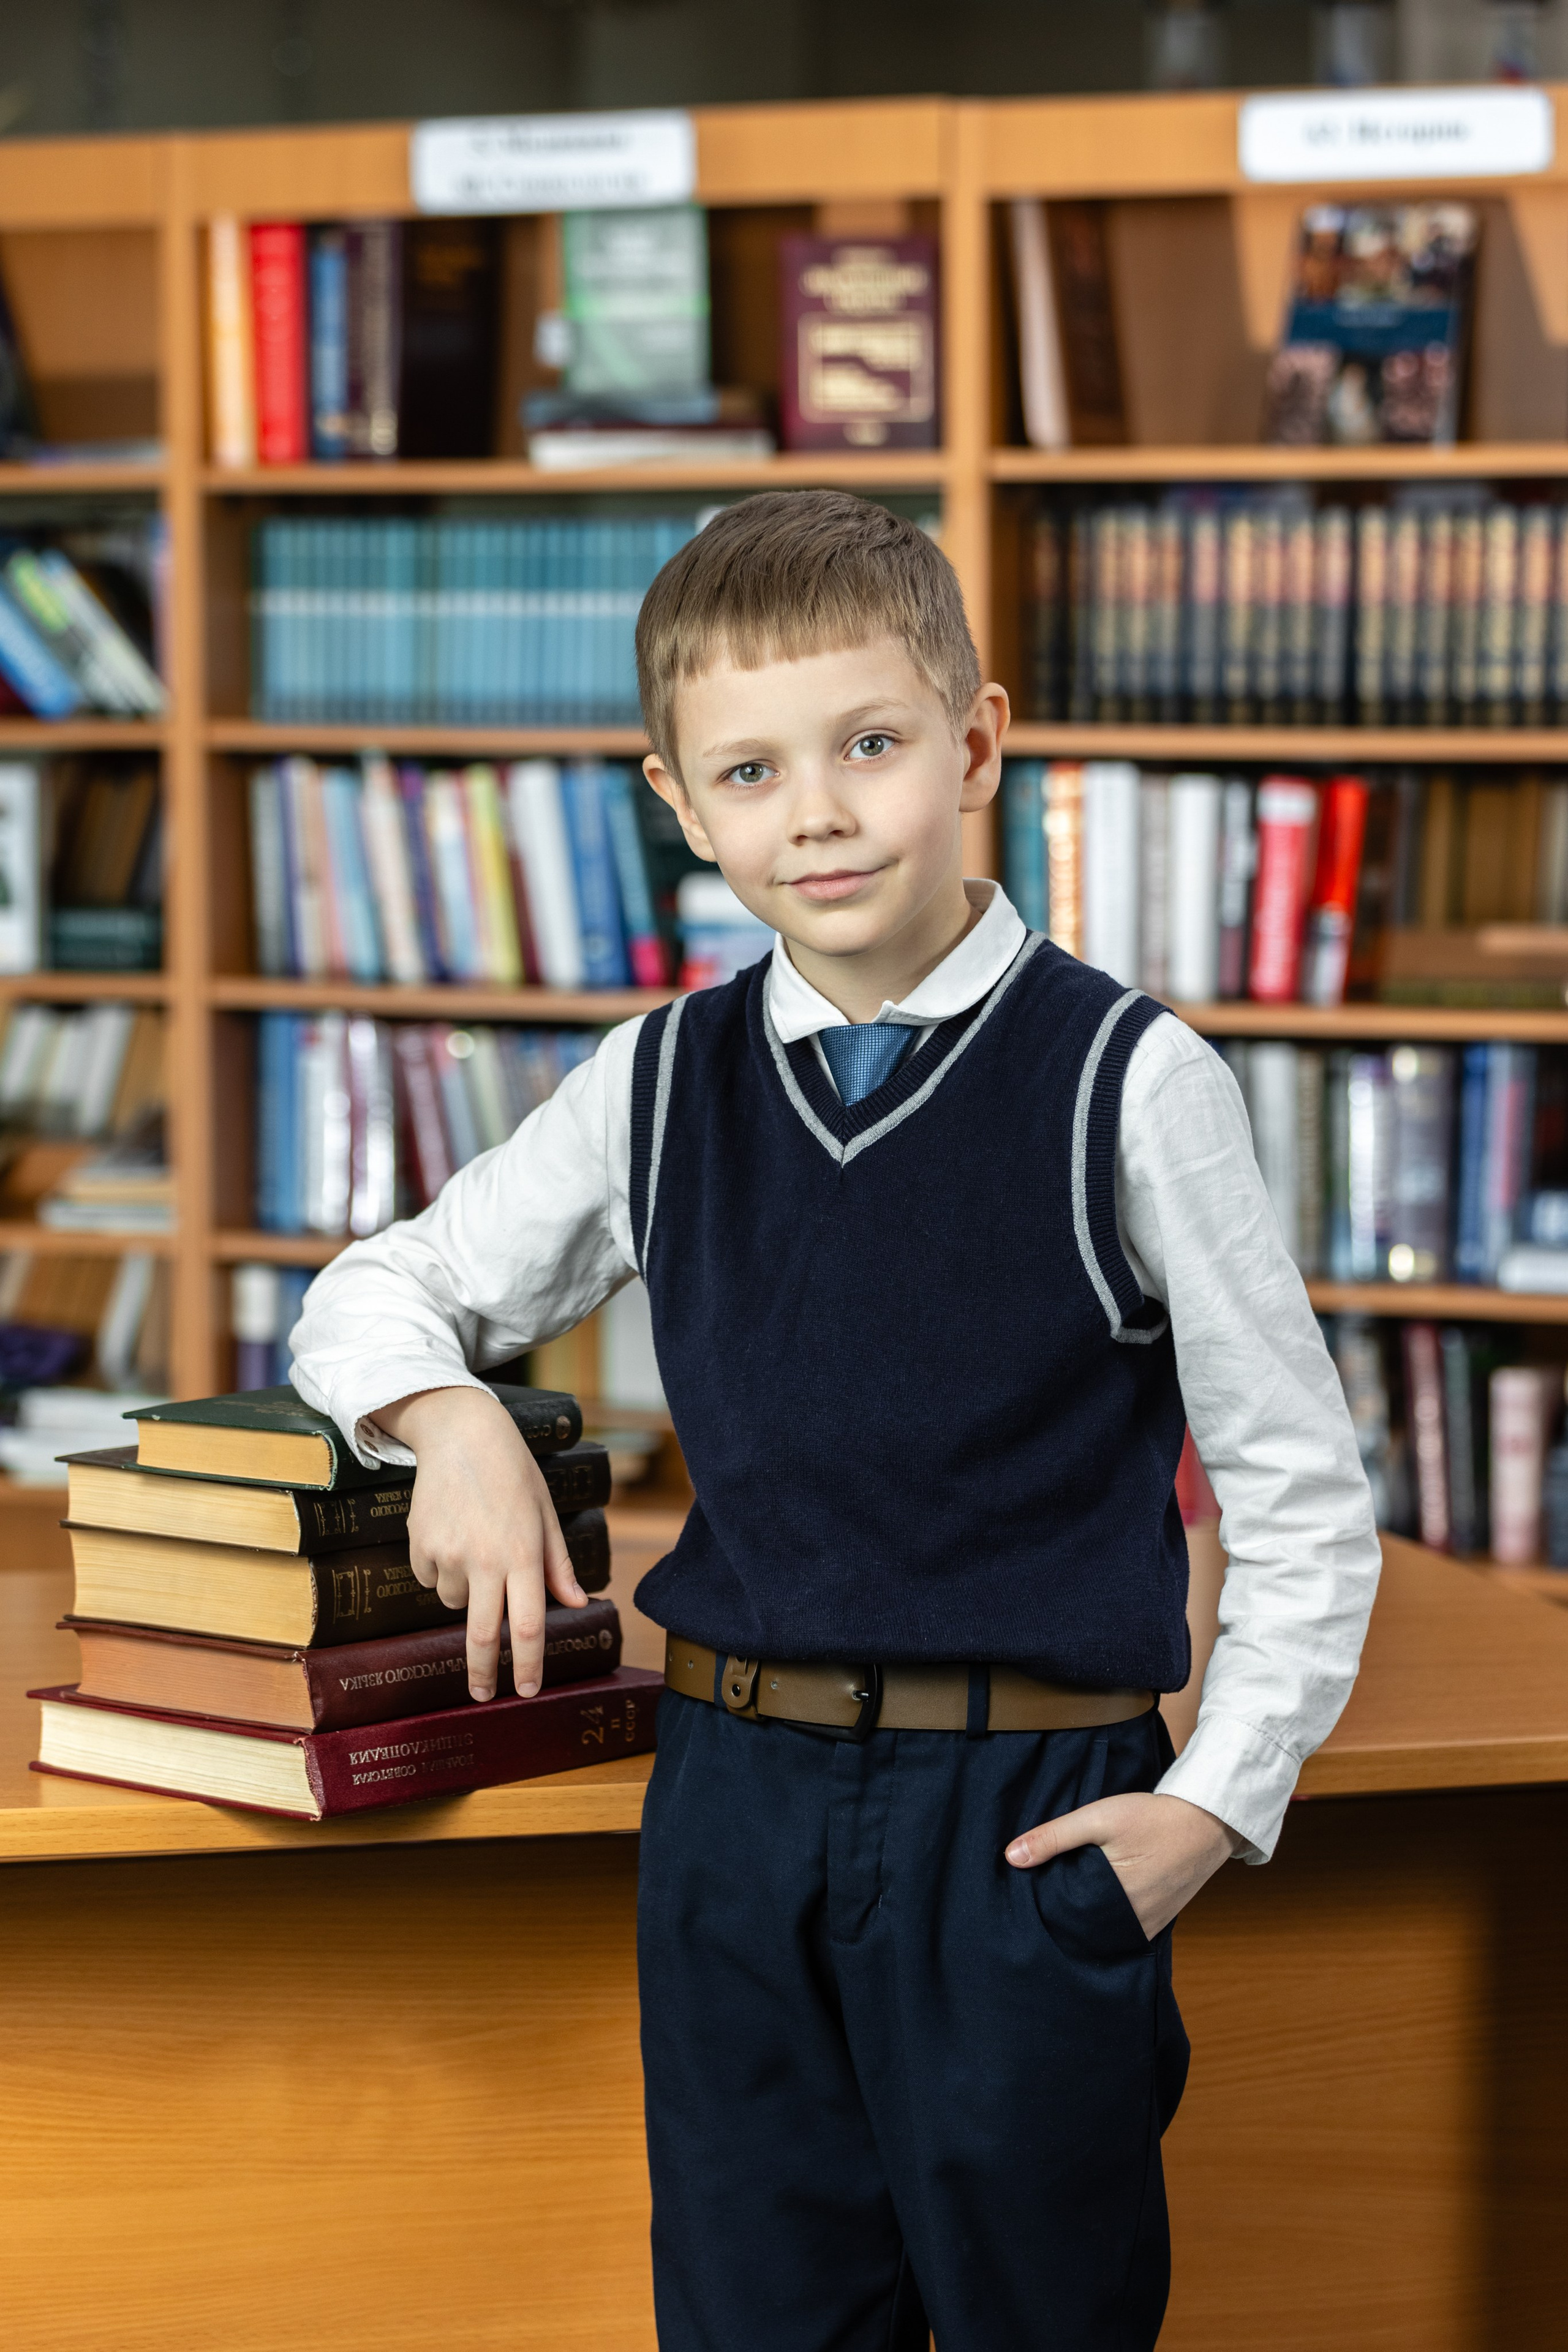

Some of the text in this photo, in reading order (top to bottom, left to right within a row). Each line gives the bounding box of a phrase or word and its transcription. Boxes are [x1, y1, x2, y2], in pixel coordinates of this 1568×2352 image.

[370, 1502, 410, 1518] РУССКОГО
[376, 1580, 421, 1599] РУССКОГО
[338, 1672, 383, 1691] ЯЗЫКА
[384, 1660, 446, 1684] РУССКОГО
[579, 1705, 605, 1745] 24
[624, 1699, 636, 1743] СССР
[349, 1733, 474, 1765] ЭНЦИКЛОПЕДИЯ
[352, 1754, 475, 1785] БОЛЬШАЯ СОВЕТСКАЯ
